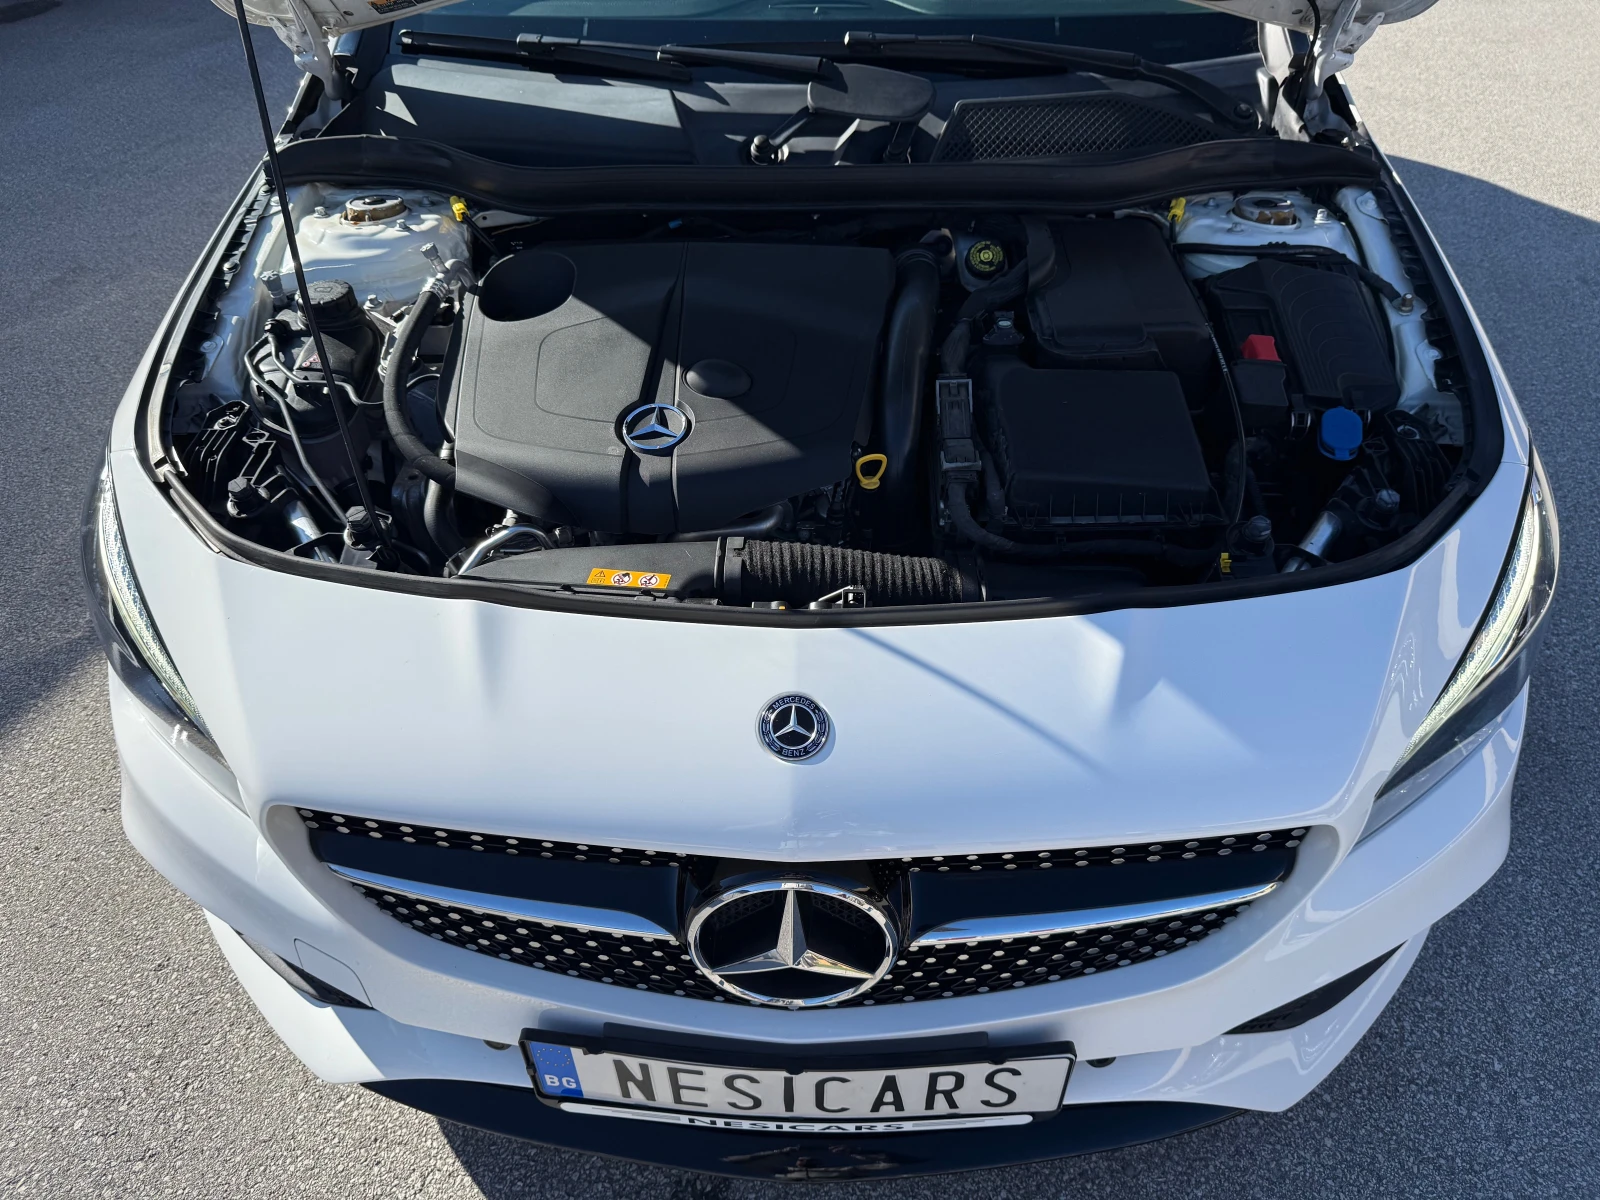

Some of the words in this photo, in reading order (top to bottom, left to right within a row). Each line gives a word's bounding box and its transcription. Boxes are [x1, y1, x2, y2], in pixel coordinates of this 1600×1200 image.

[772, 696, 816, 710] MERCEDES
[782, 748, 806, 756] BENZ
[544, 1074, 577, 1089] BG
[613, 1059, 1022, 1113] NESICARS
[687, 1117, 905, 1131] NESICARS
